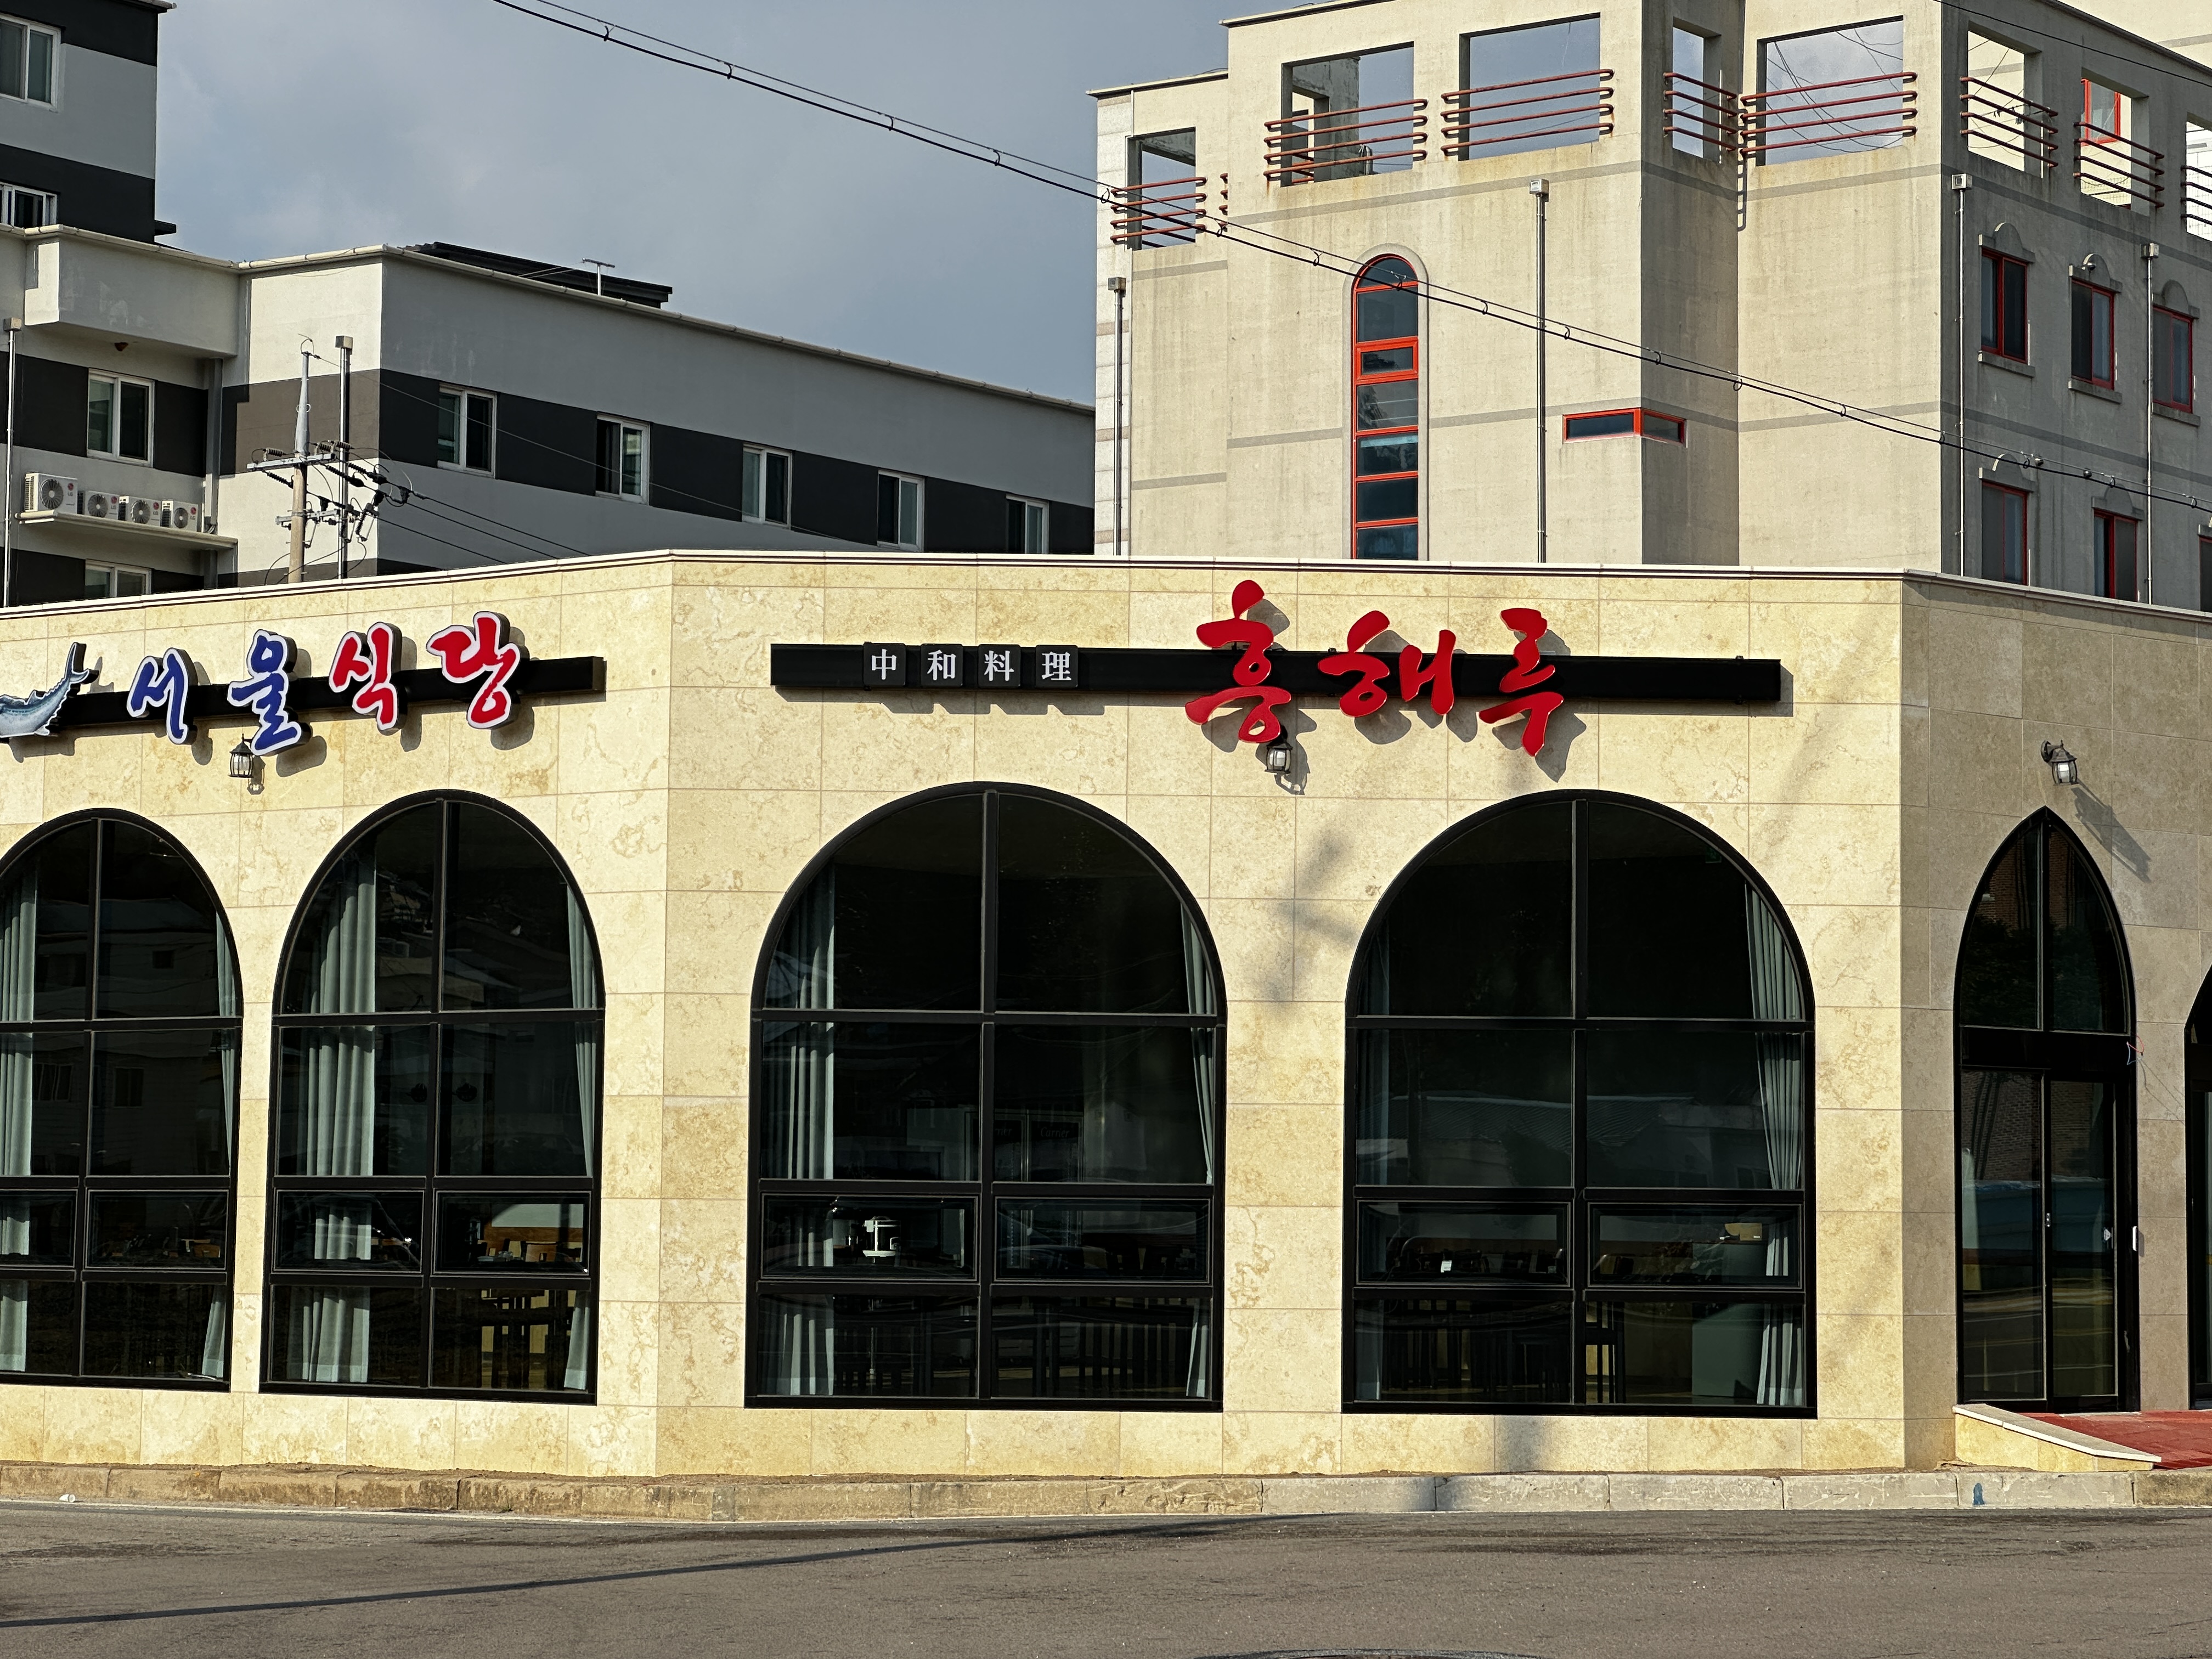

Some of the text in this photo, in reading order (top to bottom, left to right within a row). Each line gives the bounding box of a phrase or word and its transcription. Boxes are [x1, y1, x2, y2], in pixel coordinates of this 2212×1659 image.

[127, 612, 520, 755] 서울식당
[871, 648, 1072, 681] 中和料理
[1186, 580, 1564, 757] 흥해루
[1041, 1126, 1070, 1138] Carrier
